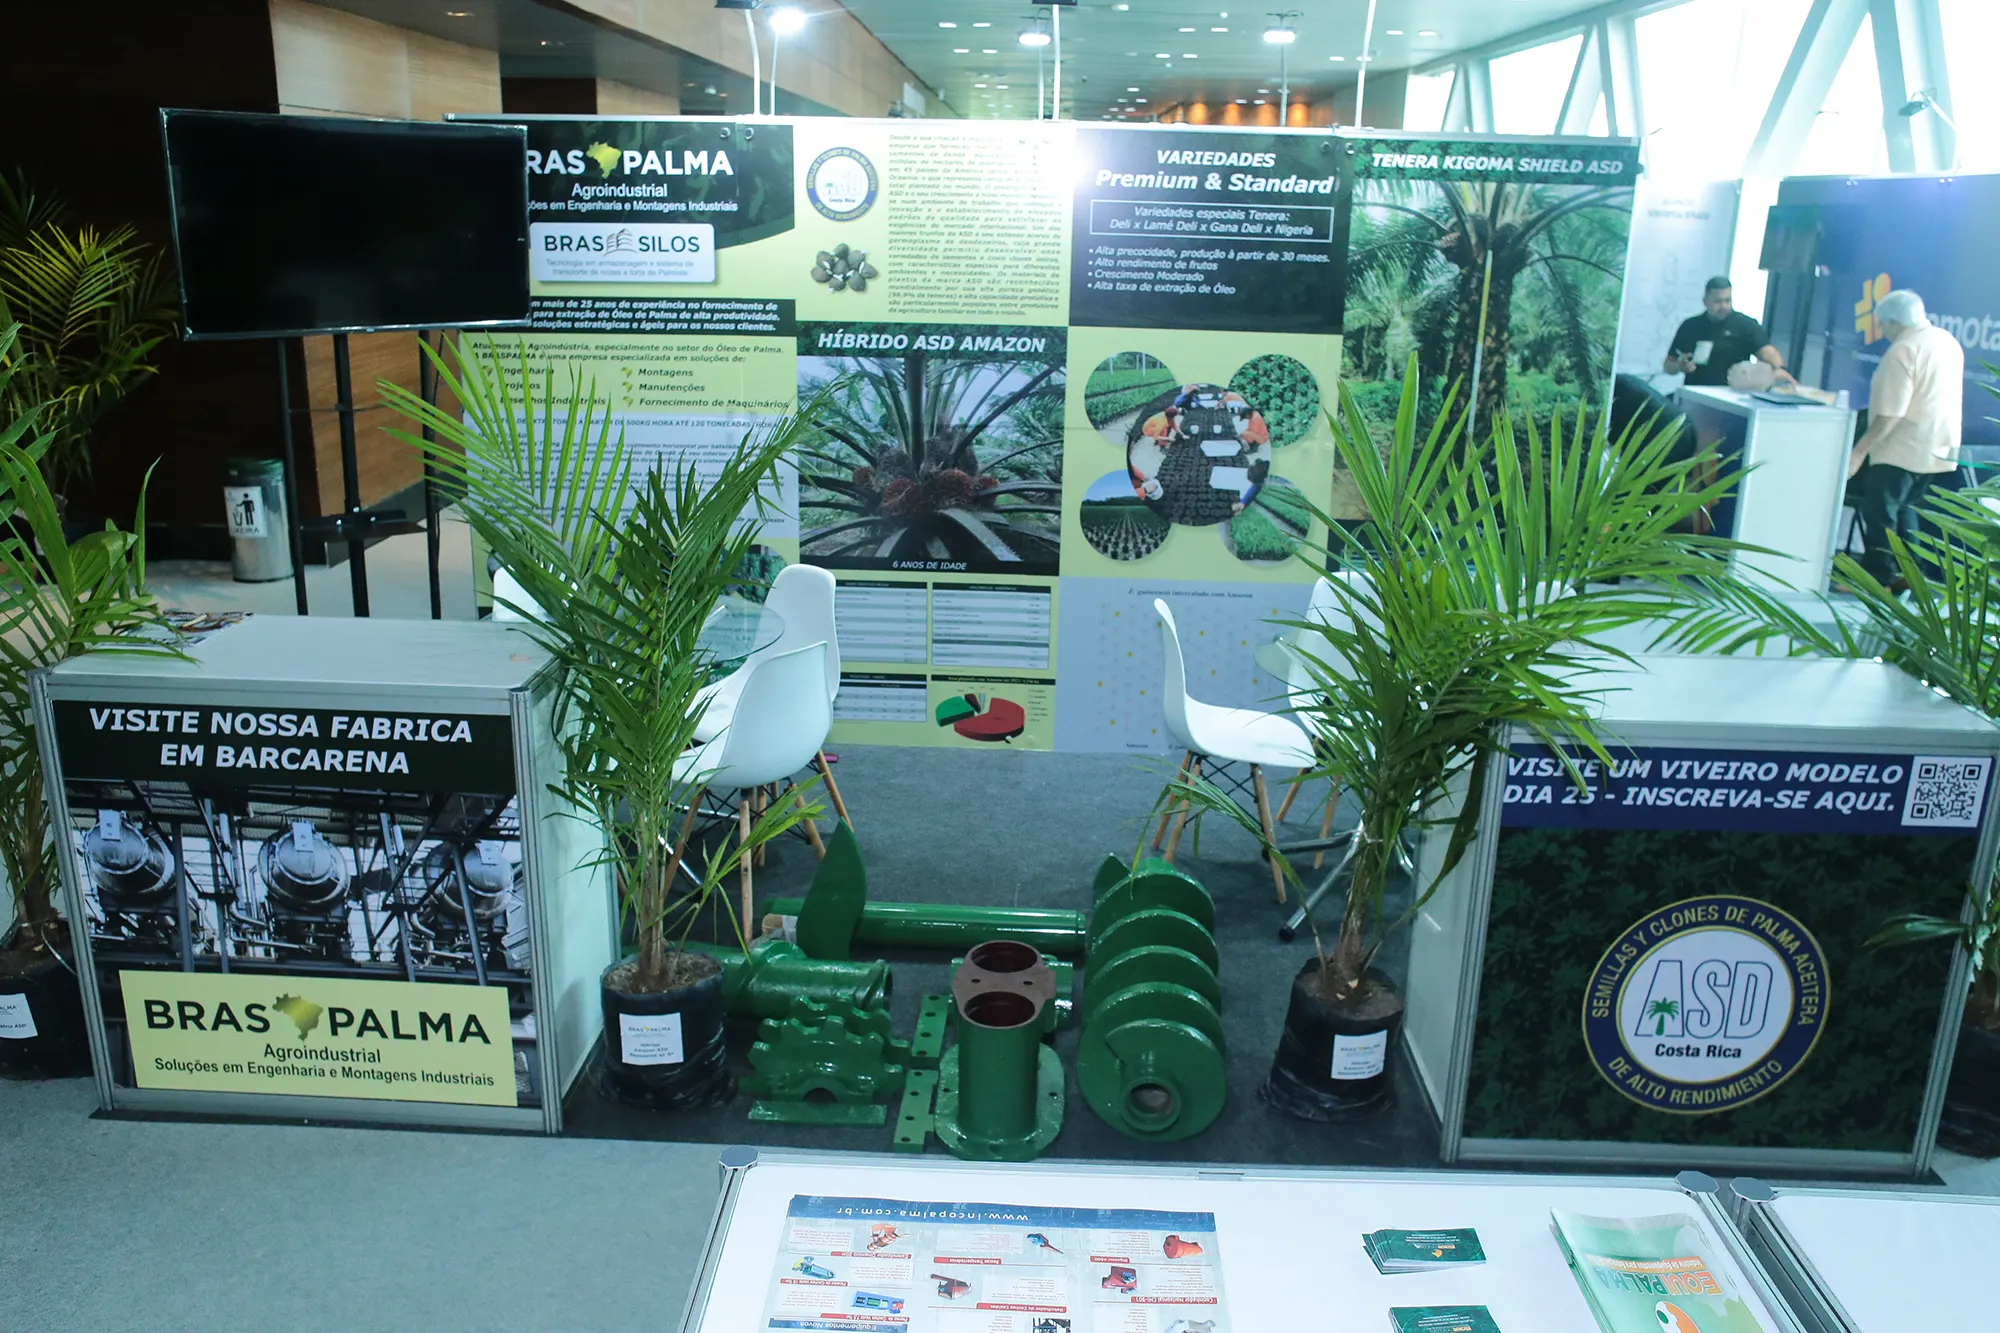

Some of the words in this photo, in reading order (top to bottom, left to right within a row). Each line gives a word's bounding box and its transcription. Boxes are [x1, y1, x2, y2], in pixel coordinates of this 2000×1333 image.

[526, 150, 586, 175] RAS
[623, 150, 734, 176] PALMA
[1156, 150, 1276, 168] VARIEDADES
[1372, 153, 1438, 169] TENERA
[1443, 156, 1513, 172] KIGOMA
[1518, 157, 1584, 174] SHIELD
[1586, 160, 1622, 174] ASD
[1096, 169, 1198, 189] Premium
[1204, 172, 1222, 190] &
[1228, 173, 1334, 194] Standard
[572, 183, 668, 200] Agroindustrial
[550, 202, 566, 210] em
[568, 200, 622, 212] Engenharia
[633, 201, 686, 213] Montagens
[689, 201, 738, 212] Industriais
[1134, 206, 1194, 218] Variedades
[1196, 209, 1246, 222] especiais
[1249, 210, 1290, 221] Tenera:
[1110, 219, 1131, 230] Deli
[1133, 222, 1140, 230] x
[1143, 220, 1174, 231] Lamé
[1176, 221, 1198, 232] Deli
[1200, 224, 1207, 232] x
[1210, 222, 1238, 233] Gana
[1241, 222, 1262, 234] Deli
[1264, 226, 1272, 234] x
[1274, 224, 1314, 236] Nigeria
[544, 236, 604, 252] BRAS
[638, 236, 700, 252] SILOS
[1094, 246, 1114, 256] Alta
[1117, 246, 1177, 258] precocidade,
[1180, 248, 1226, 261] produção
[1228, 250, 1235, 259] à
[1236, 250, 1264, 262] partir
[1265, 250, 1279, 260] de
[1281, 252, 1294, 262] 30
[1296, 253, 1330, 263] meses.
[1094, 258, 1114, 267] Alto
[1116, 258, 1172, 269] rendimento
[1174, 260, 1187, 270] de
[1189, 260, 1218, 271] frutos
[1094, 270, 1154, 280] Crescimento
[1156, 271, 1204, 282] Moderado
[1093, 281, 1114, 290] Alta
[1116, 282, 1137, 292] taxa
[1139, 282, 1152, 292] de
[1154, 283, 1196, 294] extração
[1198, 284, 1212, 294] de
[1213, 281, 1236, 294] Óleo
[542, 300, 564, 308] mais
[566, 300, 578, 308] de
[580, 300, 592, 308] 25
[618, 300, 630, 308] de
[632, 300, 686, 310] experiência
[702, 301, 764, 310] fornecimento
[766, 302, 778, 310] de
[556, 310, 596, 320] extração
[598, 310, 610, 318] de
[612, 308, 632, 318] Óleo
[635, 310, 646, 318] de
[648, 311, 678, 319] Palma
[680, 312, 692, 320] de
[693, 312, 711, 320] alta
[713, 312, 780, 321] produtividade.
[533, 320, 572, 328] soluções
[574, 320, 630, 330] estratégicas
[640, 320, 664, 330] ágeis
[666, 322, 688, 330] para
[690, 322, 701, 330] os
[703, 322, 735, 330] nossos
[737, 322, 776, 331] clientes.
[594, 343, 659, 351] especialmente
[676, 344, 700, 352] setor
[702, 344, 714, 352] do
[716, 343, 737, 352] Óleo
[818, 329, 908, 349] HÍBRIDO
[913, 334, 954, 350] ASD
[960, 336, 1046, 352] AMAZON
[610, 354, 670, 362] especializada
[690, 354, 729, 363] soluções
[638, 368, 694, 378] Montagens
[638, 384, 706, 392] Manutenções
[639, 398, 708, 406] Fornecimento
[900, 561, 924, 569] ANOS
[926, 562, 939, 570] DE
[940, 562, 968, 570] IDADE
[89, 708, 200, 734] VISITE
[210, 712, 320, 738] NOSSA
[330, 716, 473, 744] FABRICA
[160, 743, 204, 767] EM
[215, 746, 410, 774] BARCARENA
[1608, 759, 1652, 779] UM
[1660, 760, 1780, 782] VIVEIRO
[1785, 762, 1903, 785] MODELO
[1502, 784, 1552, 804] DIA
[1622, 786, 1811, 810] INSCREVA-SE
[1814, 790, 1895, 814] AQUI.
[1592, 942, 1638, 1018] SEMILLAS
[1633, 931, 1648, 946] Y
[1650, 905, 1720, 938] CLONES
[1724, 905, 1750, 924] DE
[1750, 912, 1802, 954] PALMA
[1792, 953, 1820, 1026] ACEITERA
[1634, 959, 1773, 1040] ASD
[144, 999, 271, 1034] BRAS
[328, 1006, 492, 1045] PALMA
[264, 1043, 381, 1064] Agroindustrial
[1654, 1043, 1700, 1058] Costa
[1706, 1044, 1742, 1059] Rica
[154, 1057, 218, 1076] Soluções
[222, 1063, 244, 1074] em
[248, 1062, 326, 1079] Engenharia
[329, 1068, 338, 1078] e
[342, 1066, 418, 1084] Montagens
[422, 1070, 494, 1087] Industriais
[1608, 1056, 1632, 1078] DE
[1626, 1072, 1666, 1100] ALTO
[1670, 1059, 1782, 1106] RENDIMIENTO
[837, 1208, 1029, 1221] www.incopalma.com.br
[1592, 1266, 1723, 1296] EQUIPALMA
